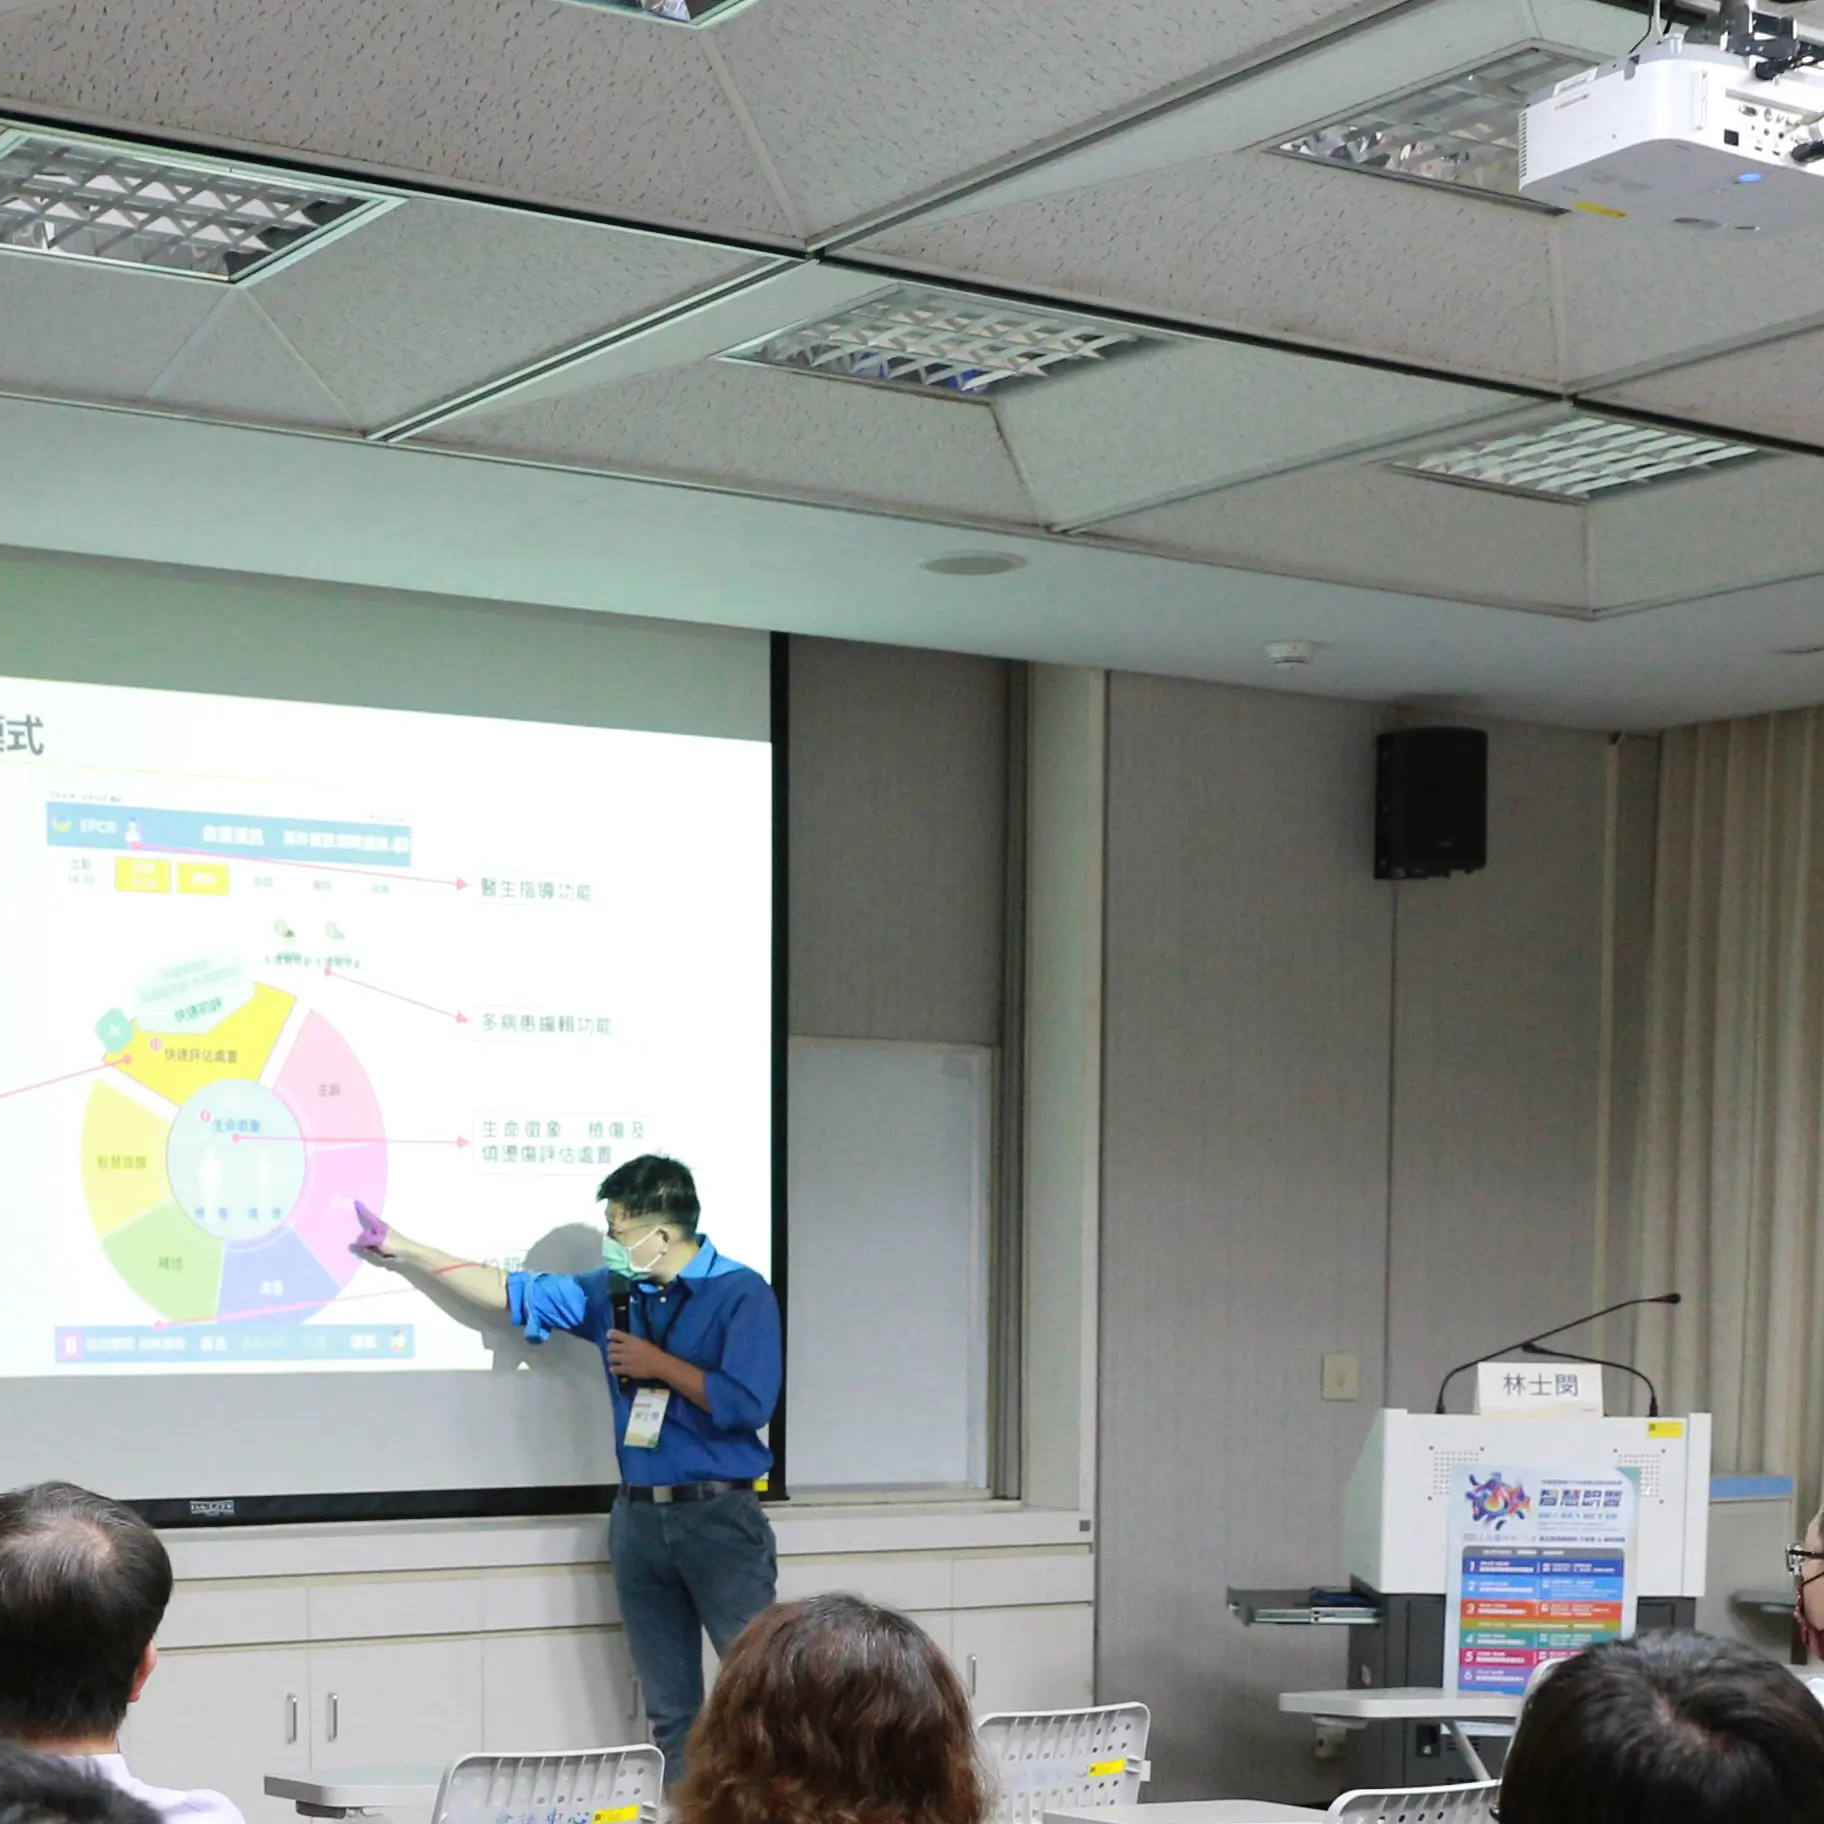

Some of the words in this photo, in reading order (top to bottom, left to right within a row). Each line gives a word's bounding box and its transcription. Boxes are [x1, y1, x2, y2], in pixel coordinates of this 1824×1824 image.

[481, 876, 594, 902] 醫生指導功能
[481, 1011, 615, 1036] 多病患編輯功能
